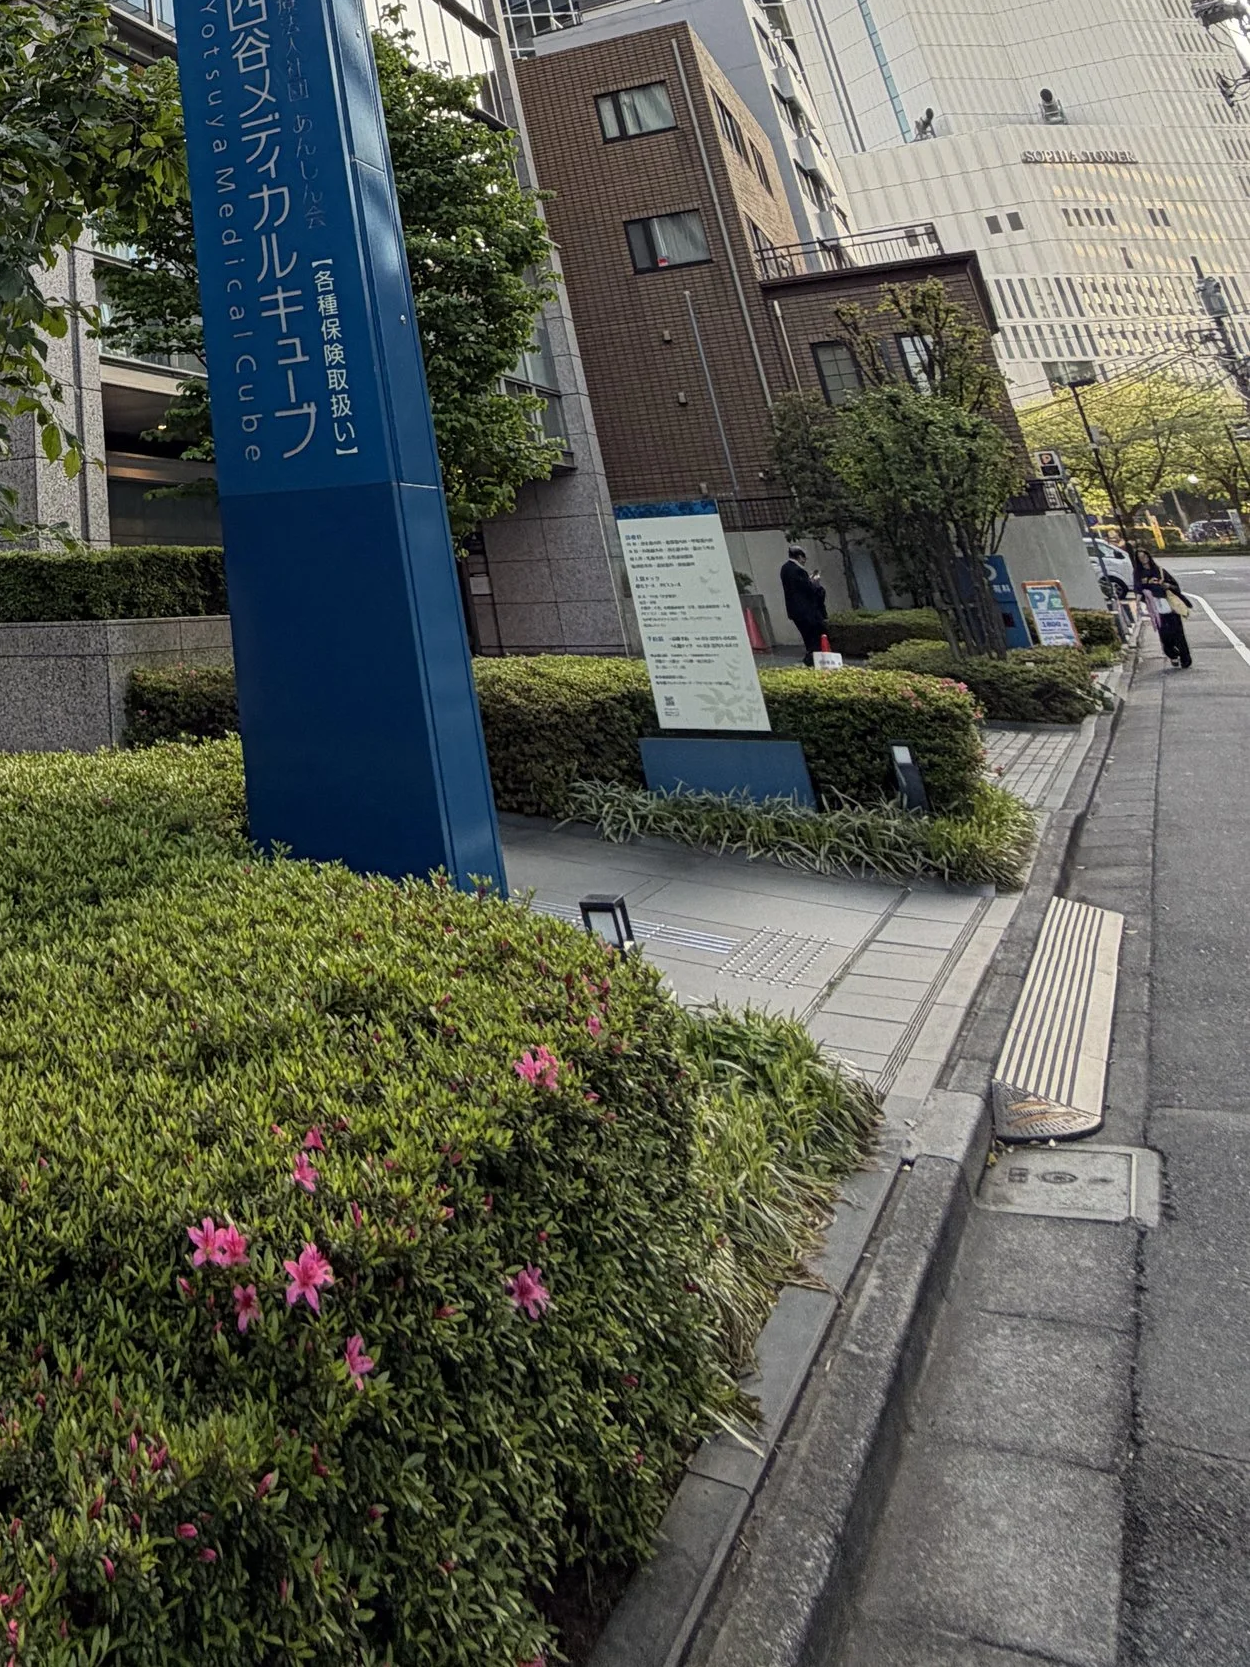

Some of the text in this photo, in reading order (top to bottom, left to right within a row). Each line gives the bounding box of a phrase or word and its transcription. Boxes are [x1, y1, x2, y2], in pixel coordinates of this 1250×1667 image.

[292, 114, 327, 230] あんしん会
[1023, 150, 1137, 163] SOPHIA TOWER
[311, 257, 359, 456] 【各種保険取扱い】
